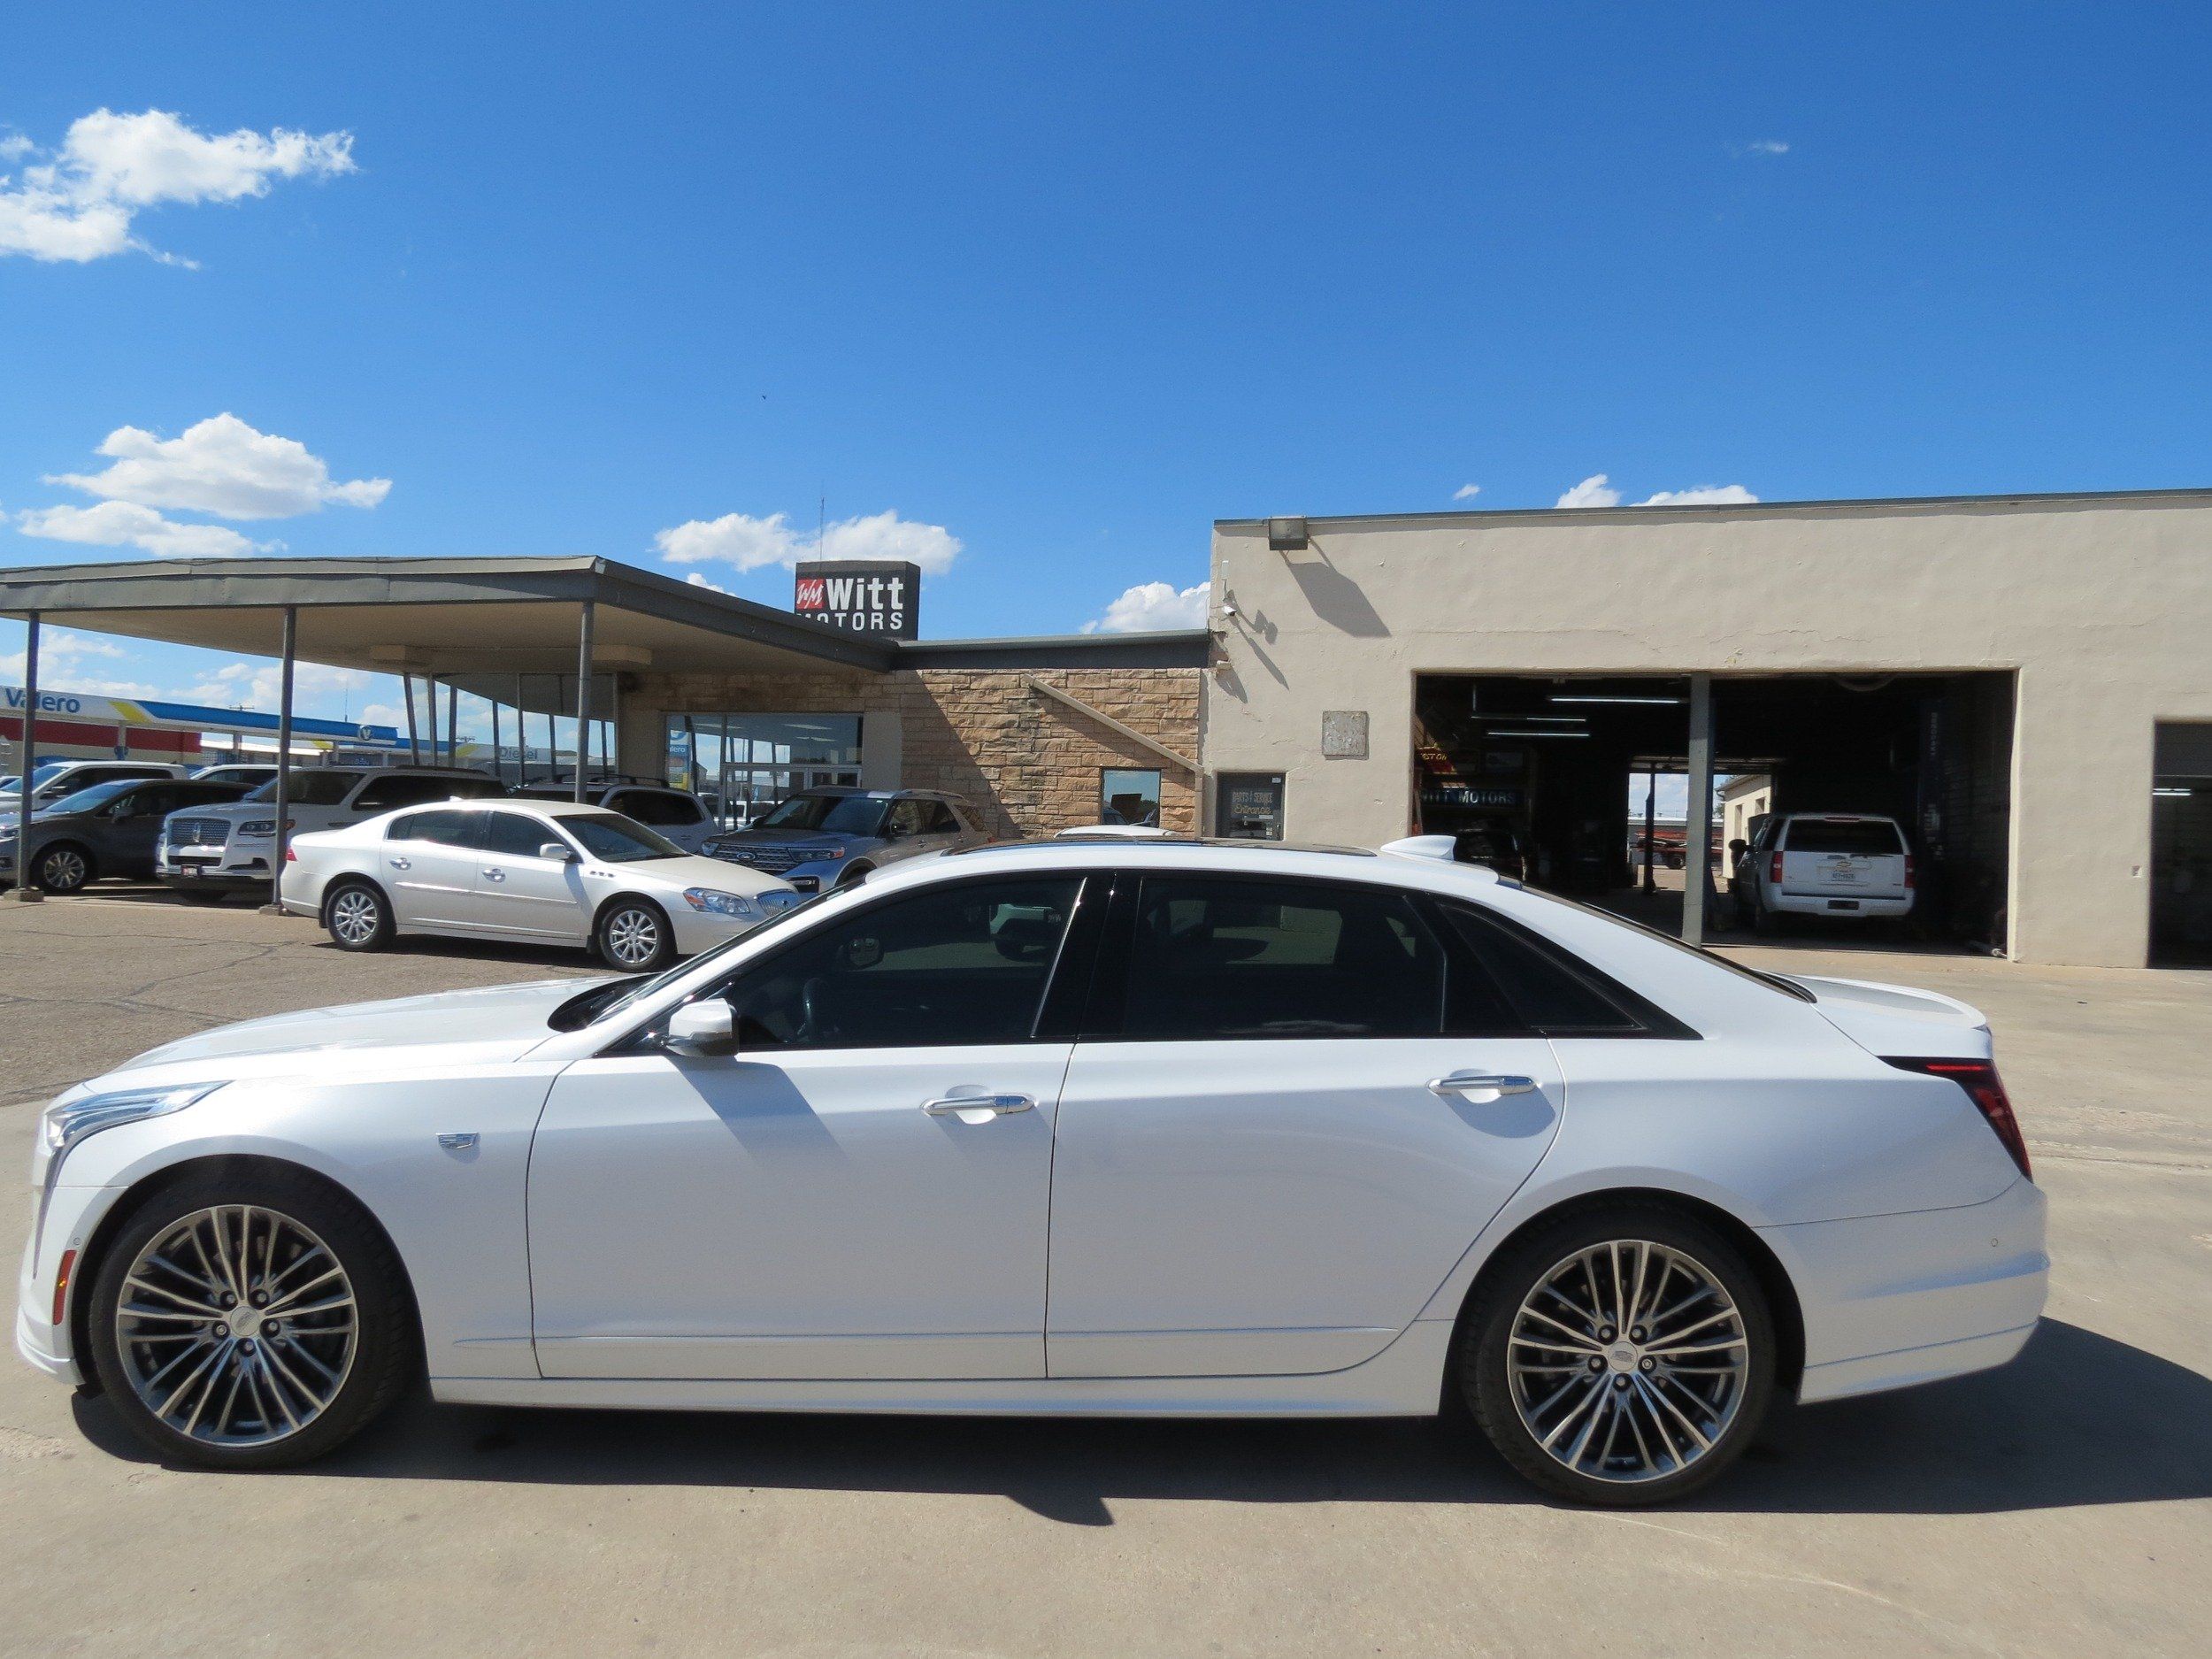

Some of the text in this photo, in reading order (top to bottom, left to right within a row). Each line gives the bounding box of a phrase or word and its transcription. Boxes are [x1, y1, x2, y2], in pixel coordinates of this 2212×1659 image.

[826, 577, 903, 611] Witt
[796, 611, 903, 631] OTORS
[500, 746, 538, 760] Dieel
[1458, 789, 1516, 804] MOTORS
